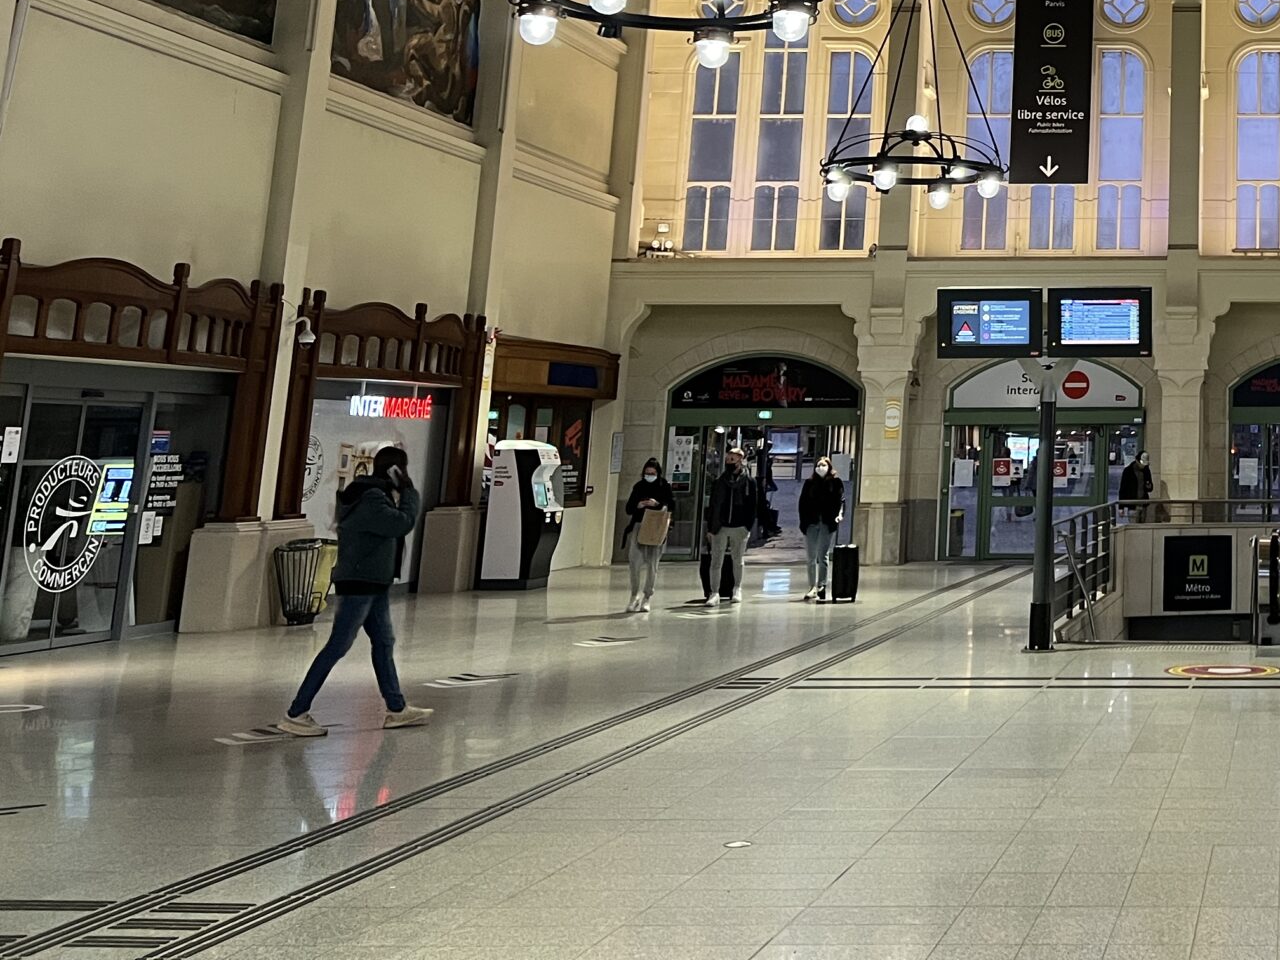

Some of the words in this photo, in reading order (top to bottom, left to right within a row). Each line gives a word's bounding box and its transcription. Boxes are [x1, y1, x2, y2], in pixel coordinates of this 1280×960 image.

[1045, 0, 1066, 8] Parvis
[1046, 29, 1062, 38] BUS
[1035, 95, 1067, 106] Vélos
[1017, 109, 1043, 120] libre
[1045, 109, 1085, 120] service
[722, 374, 777, 388] MADAME
[349, 395, 432, 419] INTERMARCHÉ
[27, 459, 100, 532] PRODUCTEURS
[1185, 583, 1211, 592] Métro
